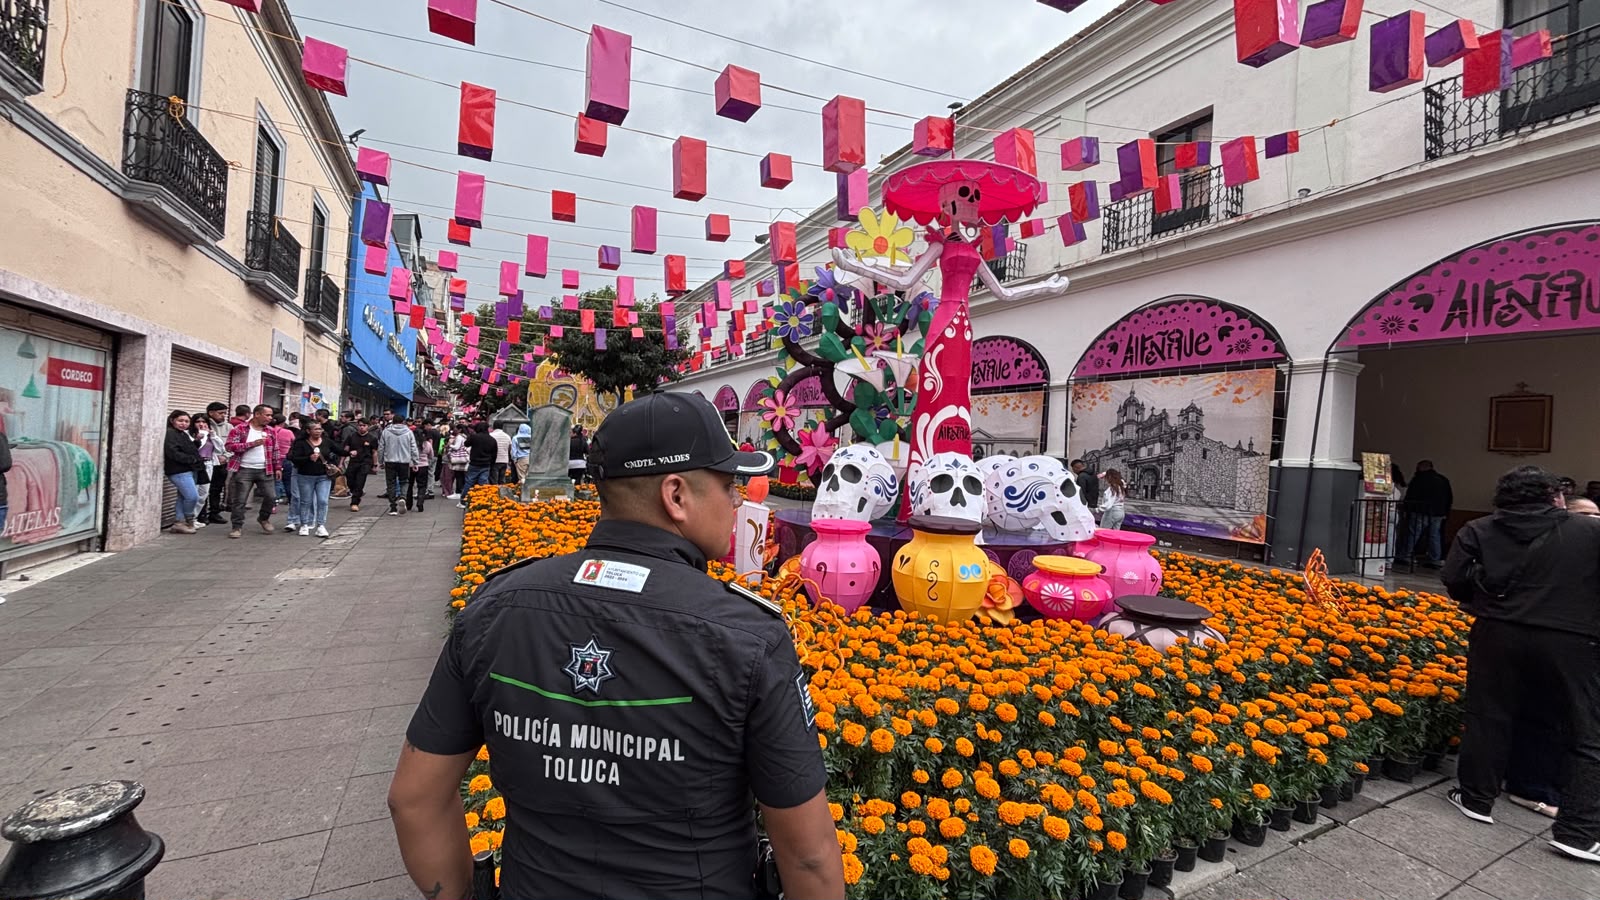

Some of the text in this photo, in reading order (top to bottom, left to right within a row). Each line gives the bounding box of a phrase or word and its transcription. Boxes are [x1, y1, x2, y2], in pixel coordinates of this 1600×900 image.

[61, 368, 93, 383] CORDECO
[624, 453, 690, 469] CMDTE. VALDES
[494, 710, 685, 762] POLICÍA MUNICIPAL
[542, 755, 620, 786] TOLUCA
